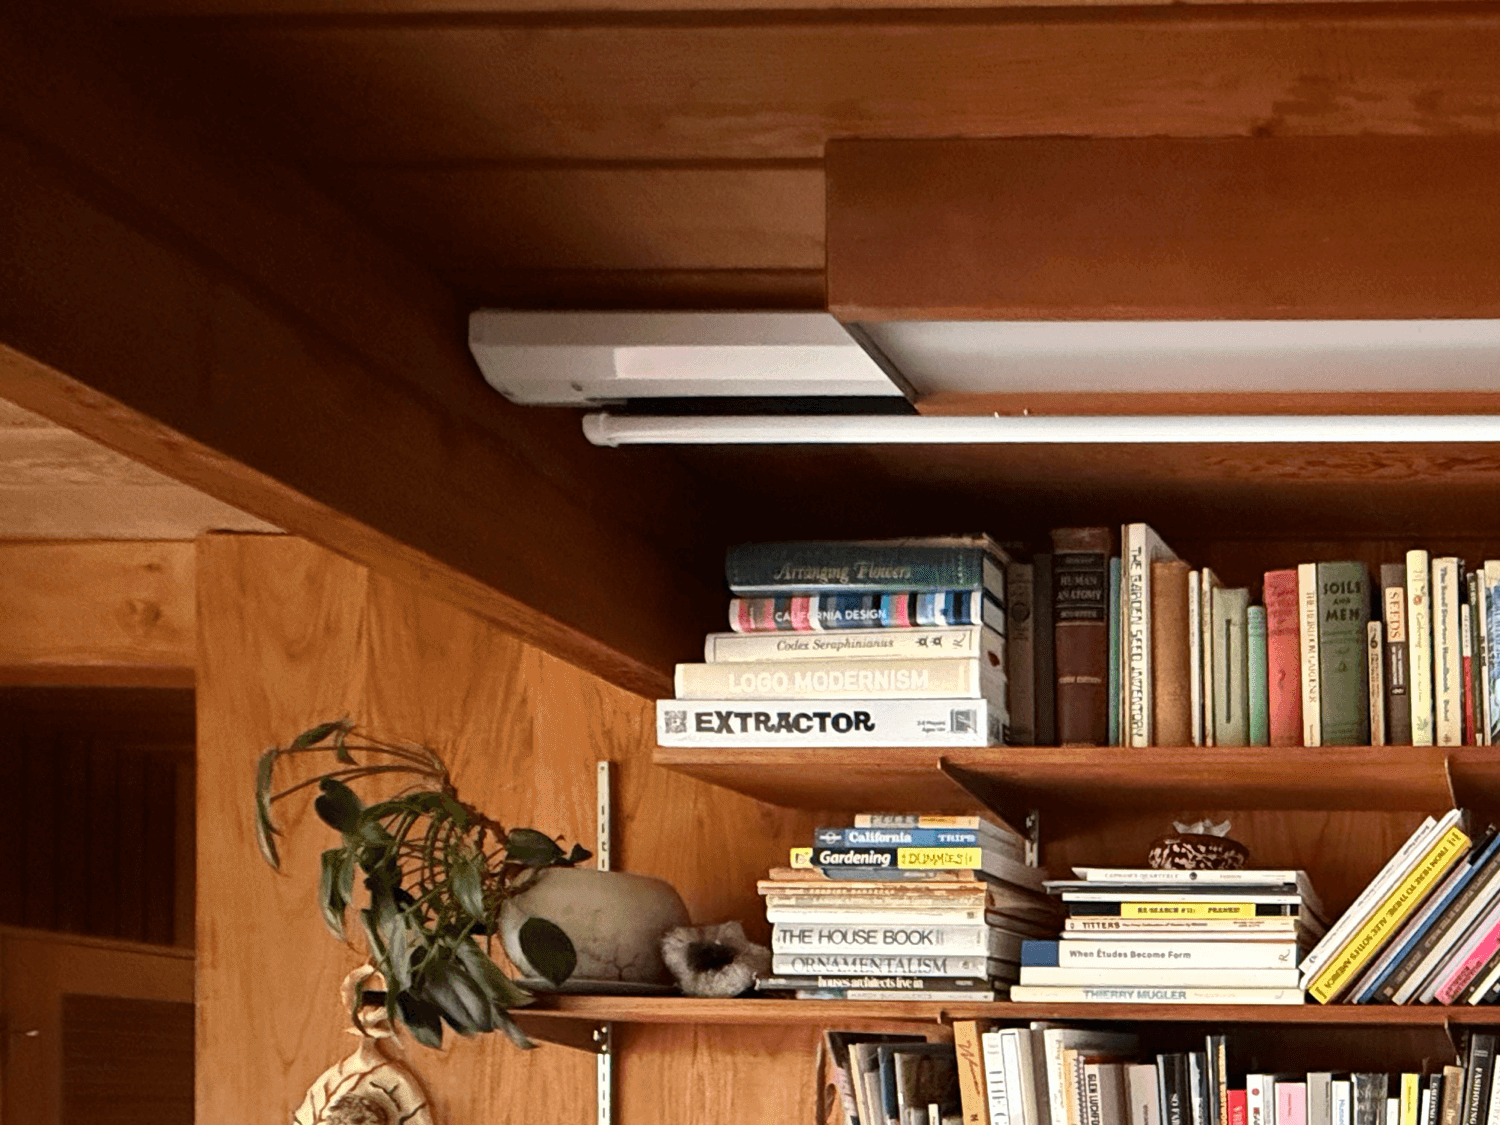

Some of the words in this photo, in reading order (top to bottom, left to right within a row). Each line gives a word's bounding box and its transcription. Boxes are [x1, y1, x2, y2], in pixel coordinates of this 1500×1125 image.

[1324, 580, 1362, 595] SOILS
[844, 608, 888, 621] DESIGN
[1326, 607, 1361, 623] MEN
[1389, 591, 1402, 640] SEEDS
[777, 639, 809, 651] Codex
[729, 673, 788, 693] LOGO
[794, 669, 929, 692] MODERNISM
[694, 710, 875, 734] EXTRACTOR
[848, 832, 912, 843] California
[819, 850, 892, 867] Gardening
[1082, 921, 1121, 930] TITTERS
[779, 930, 813, 944] THE
[818, 930, 877, 945] HOUSE
[883, 930, 934, 944] BOOK
[1069, 950, 1093, 959] When
[1130, 951, 1164, 960] Become
[1167, 951, 1191, 960] Form
[791, 957, 948, 974] ORNAMENTALISM
[1084, 990, 1133, 1000] THIERRY
[1137, 990, 1186, 1000] MUGLER
[1087, 1074, 1098, 1095] GLEN
[1469, 1066, 1484, 1125] FASHIONING
